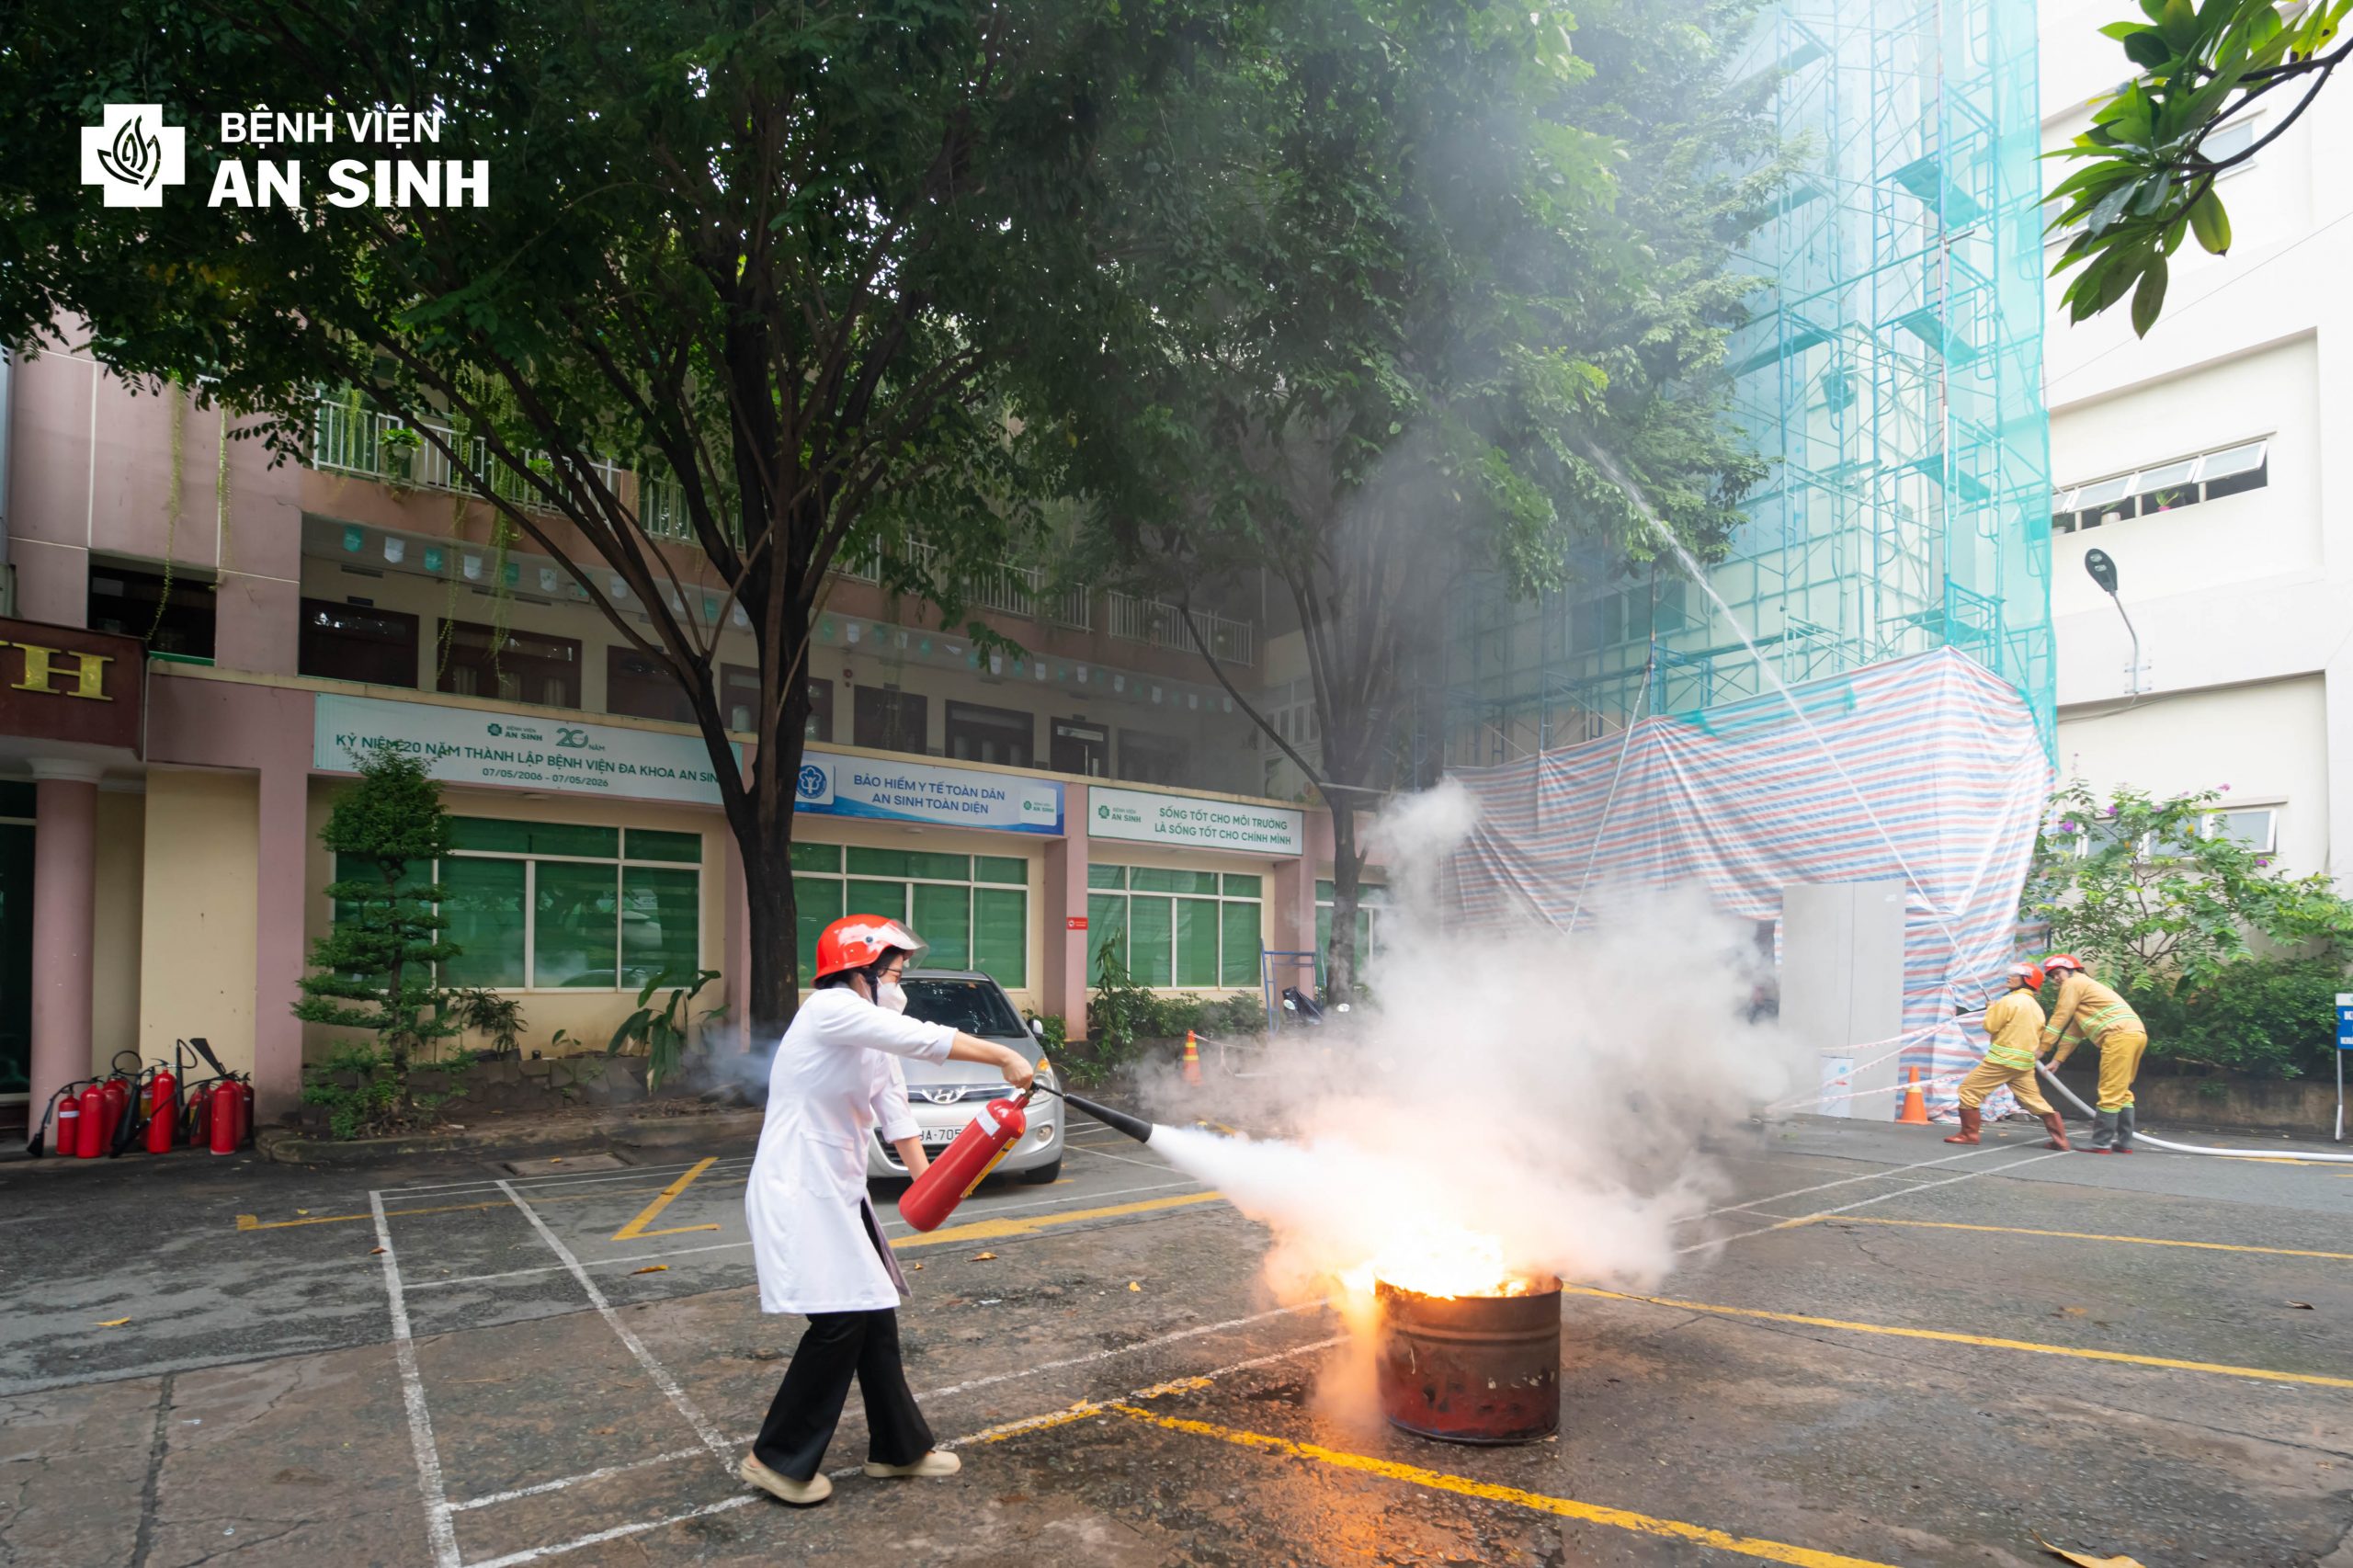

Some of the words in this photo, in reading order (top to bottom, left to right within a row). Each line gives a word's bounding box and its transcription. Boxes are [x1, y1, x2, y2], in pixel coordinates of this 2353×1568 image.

[0, 640, 115, 700] H
[505, 731, 517, 739] AN
[520, 733, 543, 741] SINH
[335, 732, 358, 747] KỶ
[403, 741, 422, 754] 20
[426, 741, 460, 757] NĂM
[464, 746, 515, 763] THÀNH
[517, 750, 544, 767] LẬP
[547, 754, 583, 770] BỆNH
[585, 758, 616, 775] VIỆN
[619, 763, 637, 775] ĐA
[640, 766, 676, 778] KHOA
[678, 769, 698, 781] AN
[699, 772, 721, 784] SIN
[482, 767, 543, 781] 07/05/2006
[551, 775, 609, 788] 07/05/2026
[854, 773, 881, 788] BẢO
[918, 782, 926, 791] Y
[928, 781, 944, 794] TẾ
[945, 784, 979, 798] TOÀN
[981, 787, 1006, 801] DÂN
[871, 793, 891, 804] AN
[893, 795, 924, 807] SINH
[926, 797, 960, 811] TOÀN
[961, 801, 989, 814] DIỆN
[1111, 812, 1122, 821] AN
[1123, 814, 1142, 823] SINH
[1159, 805, 1188, 820] SỐNG
[1189, 808, 1209, 821] TỐT
[1210, 813, 1231, 824] CHO
[1233, 814, 1250, 826] MÔI
[1252, 818, 1288, 830] TRƯỜNG
[1154, 821, 1166, 834] LÀ
[1168, 823, 1197, 836] SỐNG
[1199, 825, 1217, 838] TỐT
[1219, 829, 1239, 840] CHO
[1241, 830, 1268, 843] CHÍNH
[1269, 832, 1291, 845] MÌNH
